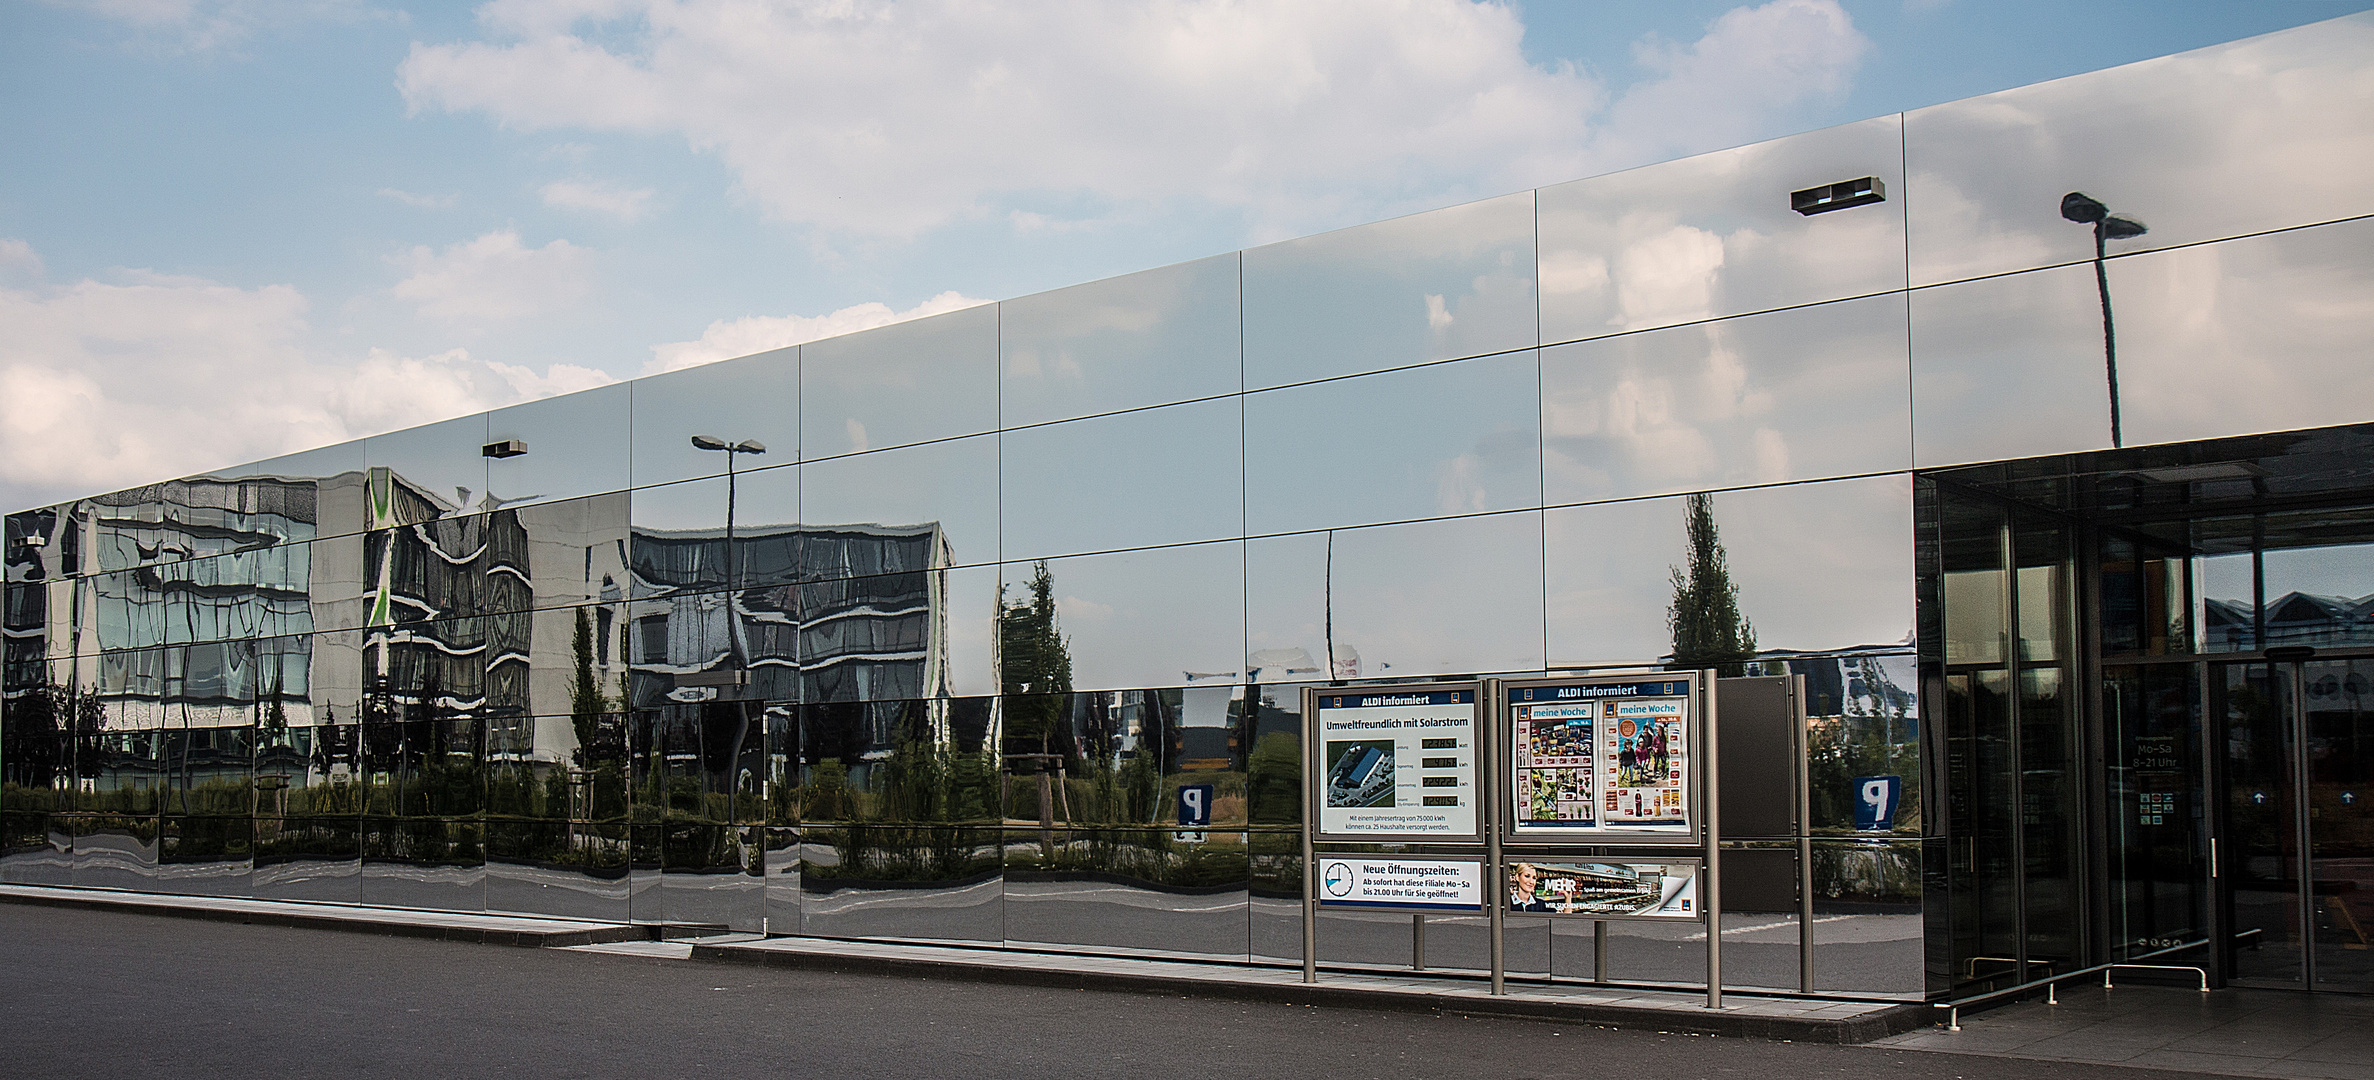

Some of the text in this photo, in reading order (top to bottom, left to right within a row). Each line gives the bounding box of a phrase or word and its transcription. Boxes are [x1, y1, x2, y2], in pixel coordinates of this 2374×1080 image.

[1557, 685, 1637, 698] ALDI informiert
[1361, 694, 1430, 707] ALDI informiert
[1533, 707, 1586, 717] meine Woche
[1620, 704, 1676, 714] meine Woche
[1326, 717, 1468, 730] Umweltfreundlich mit Solarstrom
[2158, 757, 2177, 768] Uhr
[1374, 815, 1406, 823] Jahresertrag
[1363, 863, 1460, 877] Neue Öffnungszeiten:
[1363, 878, 1372, 886] Ab
[1393, 879, 1405, 887] hat
[1406, 879, 1424, 887] diese
[1425, 880, 1445, 888] Filiale
[1545, 878, 1577, 892] MEHR
[1363, 887, 1459, 899] bis 21.00 Uhr für Sie geöffnet!
[1556, 902, 1579, 910] SUCHEN
[1579, 902, 1614, 911] ENGAGIERTE
